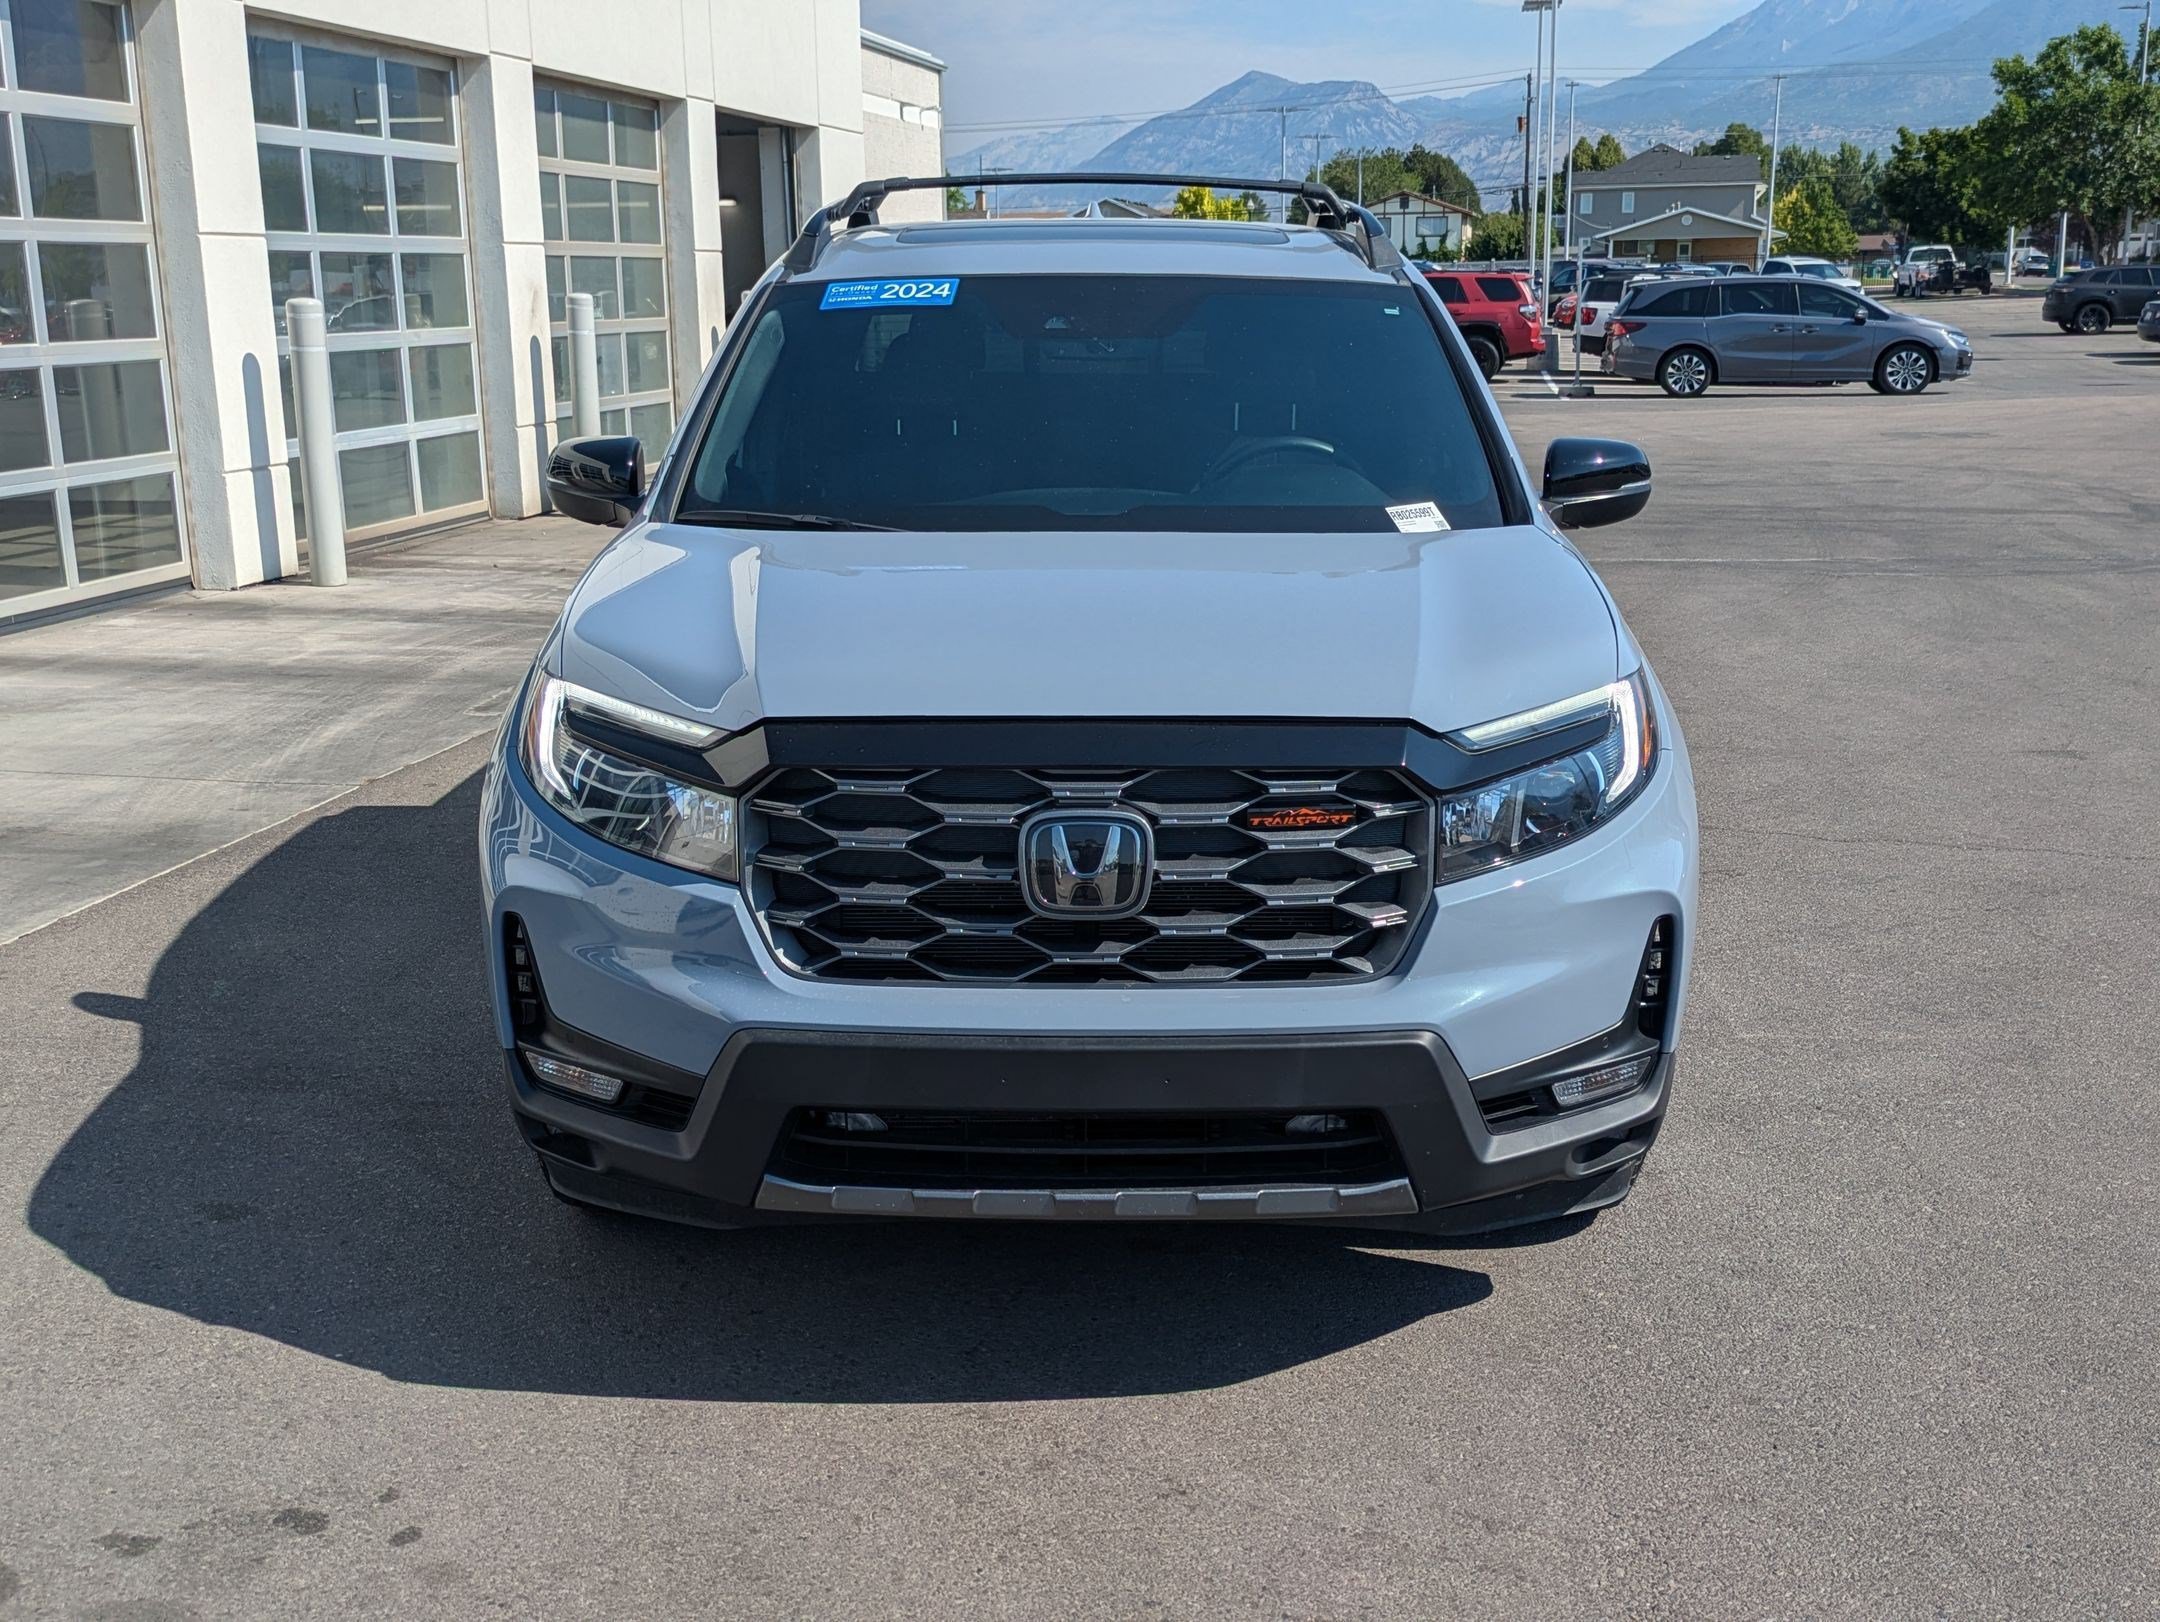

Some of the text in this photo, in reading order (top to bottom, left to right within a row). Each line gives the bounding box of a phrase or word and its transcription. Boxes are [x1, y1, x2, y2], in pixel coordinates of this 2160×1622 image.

[831, 284, 878, 293] Certified
[880, 283, 950, 299] 2024
[1250, 815, 1355, 827] TRAILSPORT
